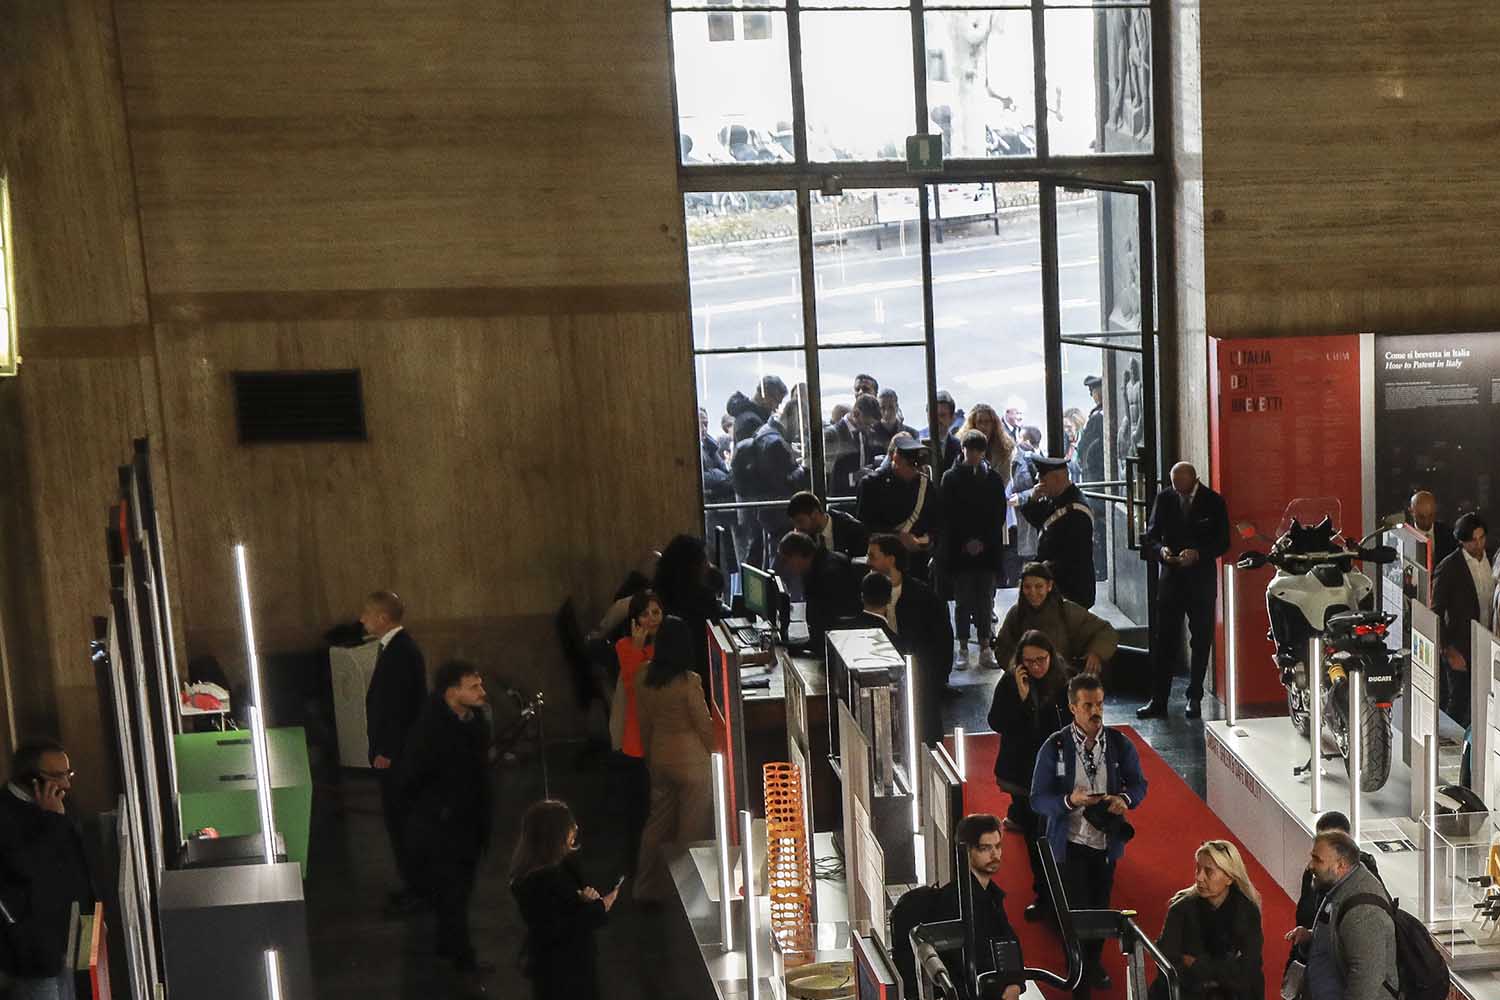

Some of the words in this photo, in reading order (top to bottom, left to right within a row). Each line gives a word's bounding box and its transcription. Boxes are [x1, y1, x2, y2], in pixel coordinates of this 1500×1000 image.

[1385, 351, 1406, 360] Come
[1407, 350, 1413, 359] si
[1415, 349, 1442, 359] brevetta
[1443, 348, 1451, 358] in
[1452, 347, 1471, 357] Italia
[1385, 361, 1403, 370] How
[1404, 361, 1412, 369] to
[1413, 360, 1436, 369] Patent
[1437, 359, 1444, 368] in
[1445, 358, 1463, 369] Italy
